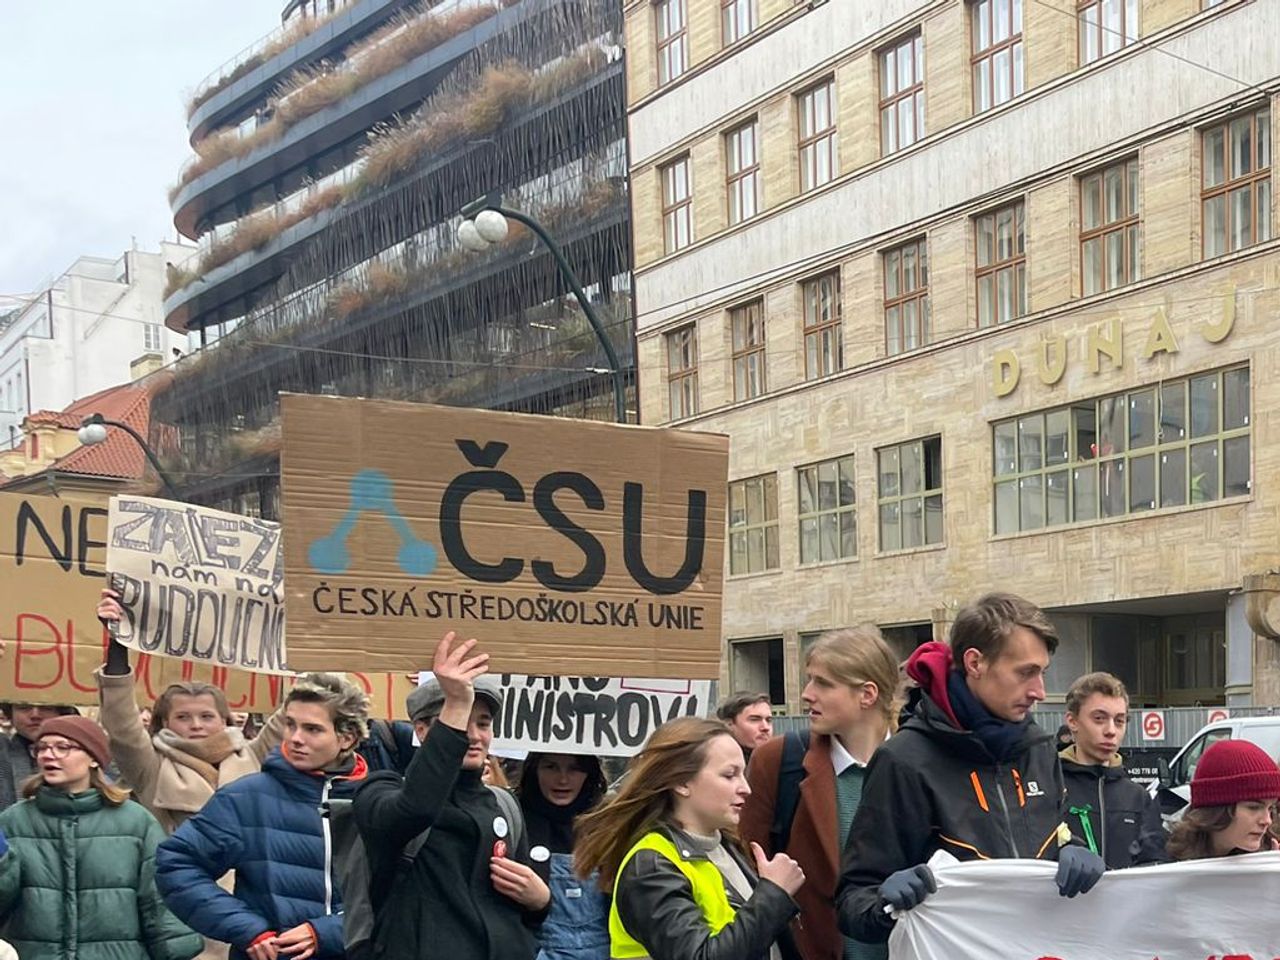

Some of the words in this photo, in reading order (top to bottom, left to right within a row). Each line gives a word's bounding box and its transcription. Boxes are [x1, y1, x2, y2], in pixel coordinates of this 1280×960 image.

[991, 283, 1238, 398] DUNAJ
[438, 439, 708, 596] ČSU
[312, 581, 418, 617] ČESKÁ
[425, 589, 639, 628] STŘEDOŠKOLSKÁ
[647, 603, 704, 630] UNIE
